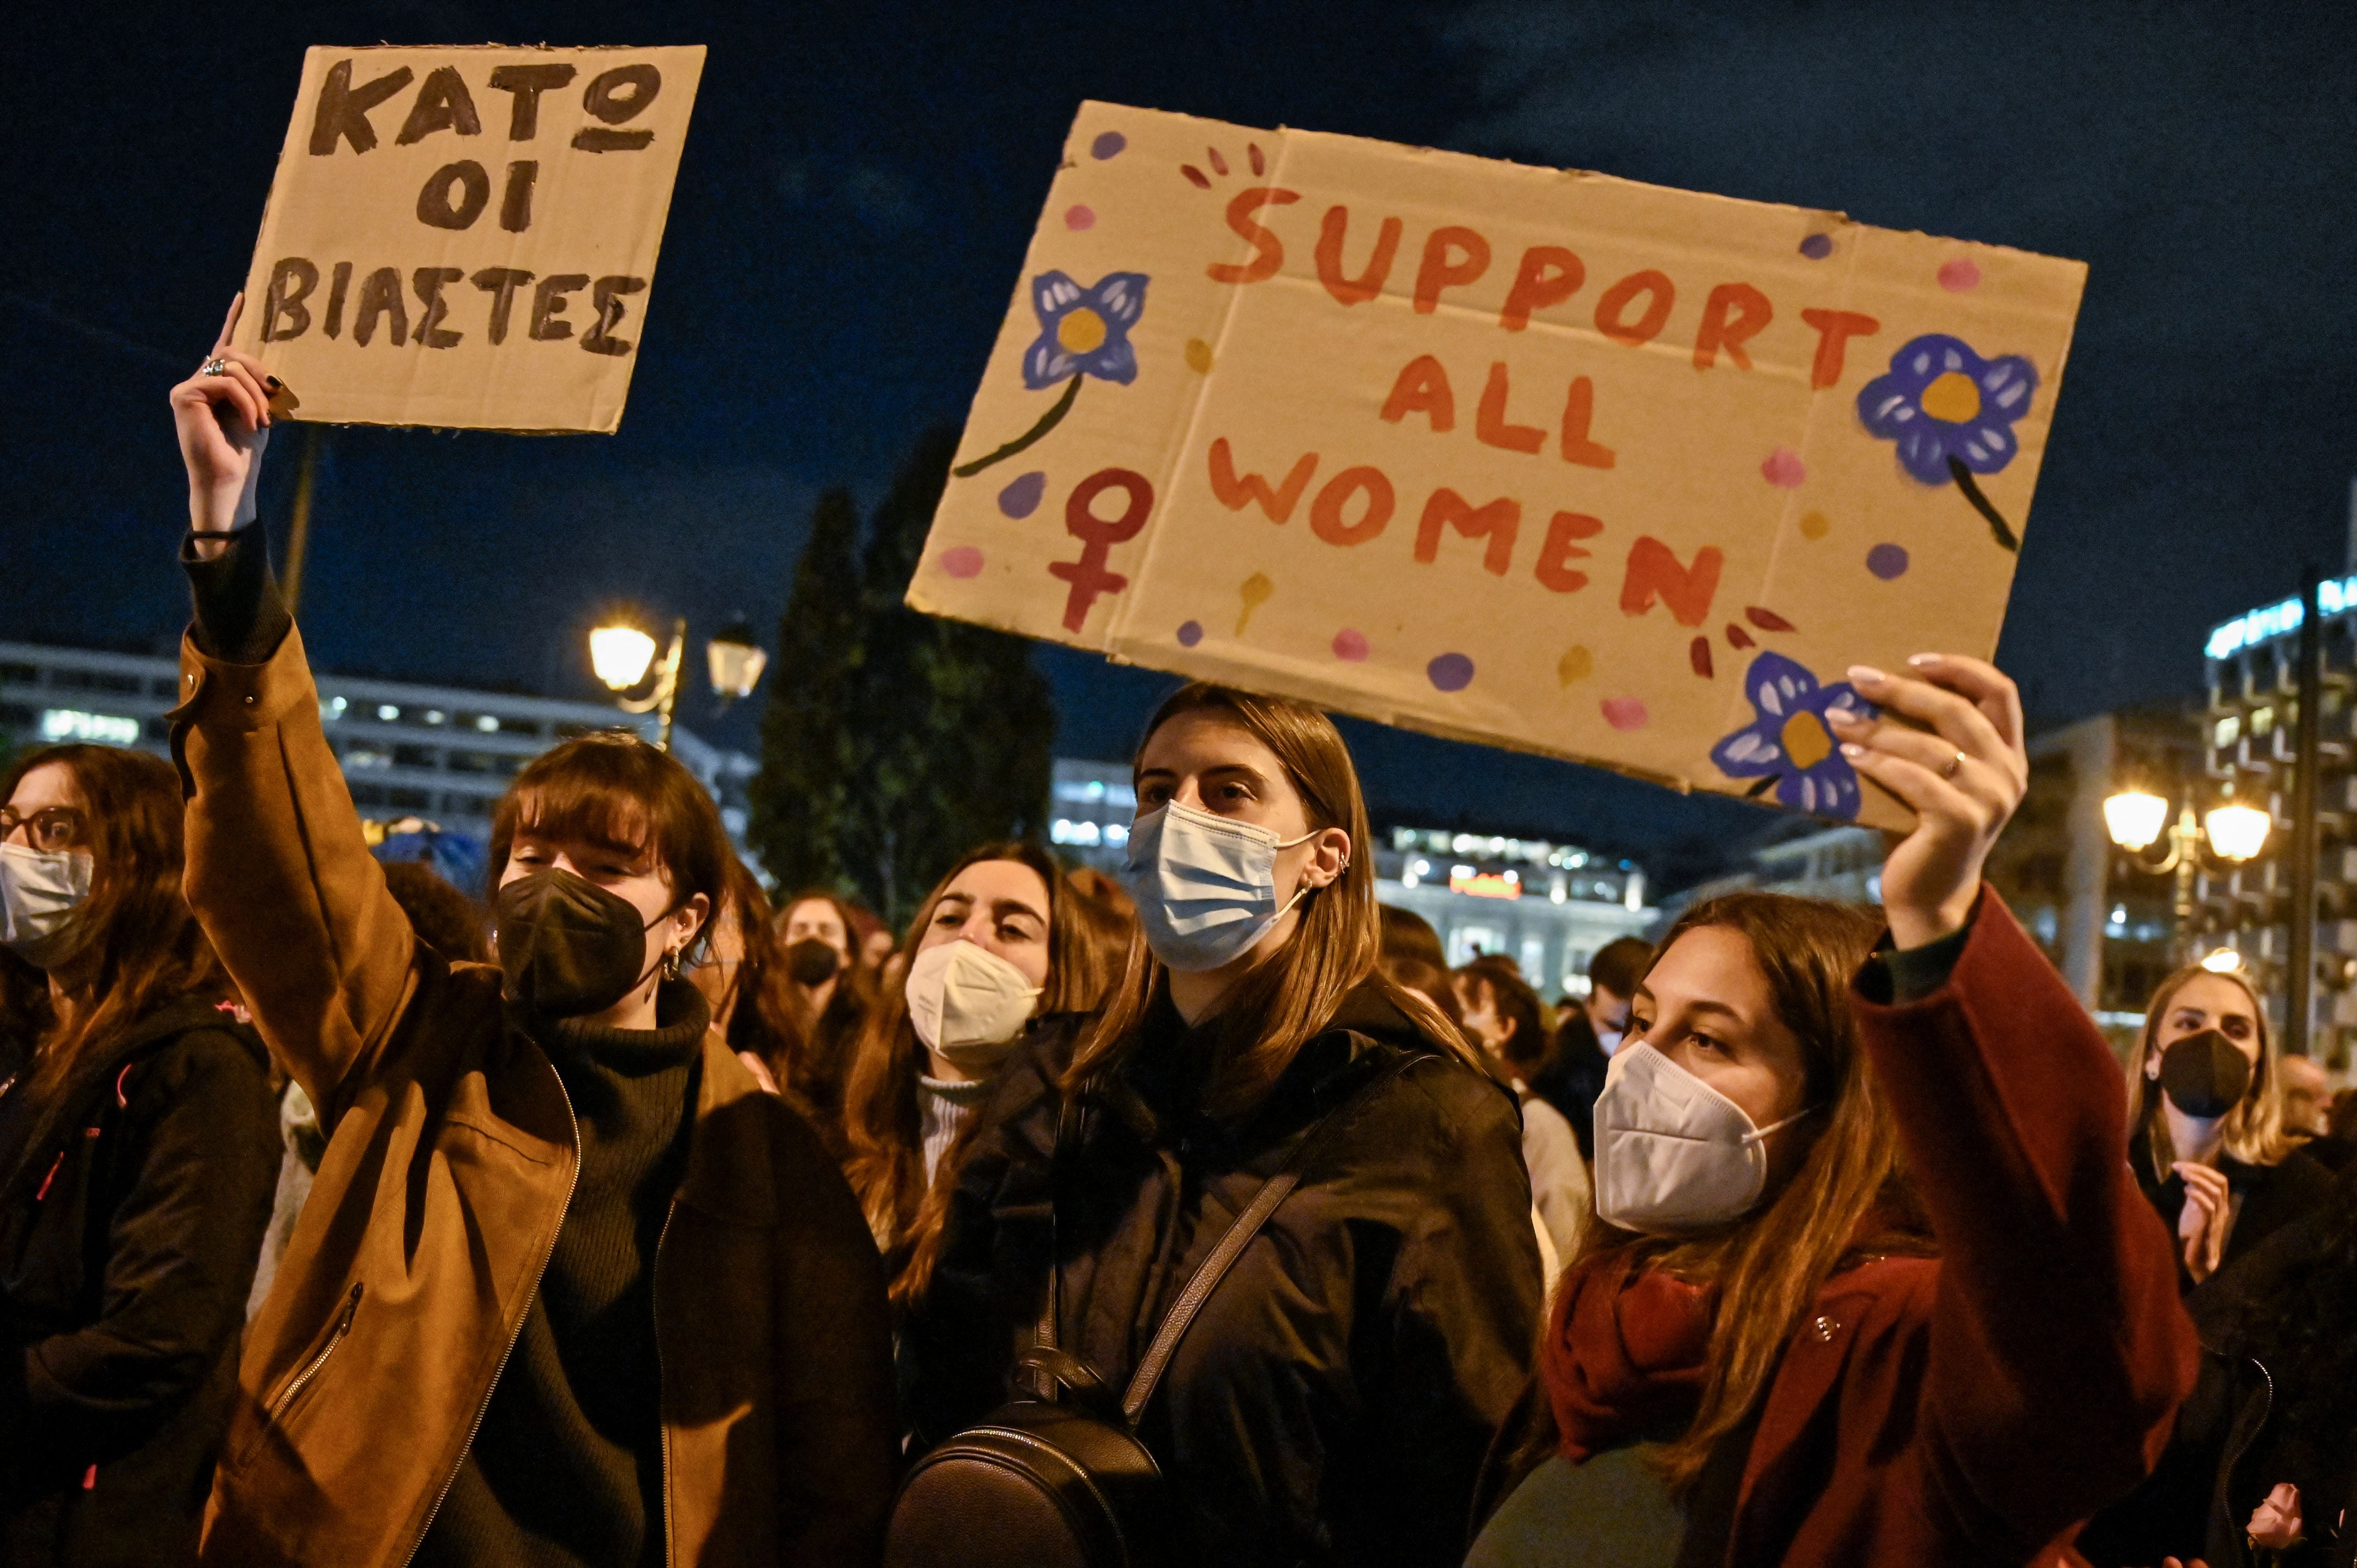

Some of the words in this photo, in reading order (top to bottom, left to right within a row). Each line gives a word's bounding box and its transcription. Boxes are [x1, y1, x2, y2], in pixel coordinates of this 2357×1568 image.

[417, 159, 539, 234] ΟΙ
[260, 257, 647, 357] ΒΙΑΣΤΕΣ
[1205, 187, 1880, 390] SUPPORT
[1380, 354, 1616, 469] ALL
[1208, 436, 1724, 627] WOMEN
